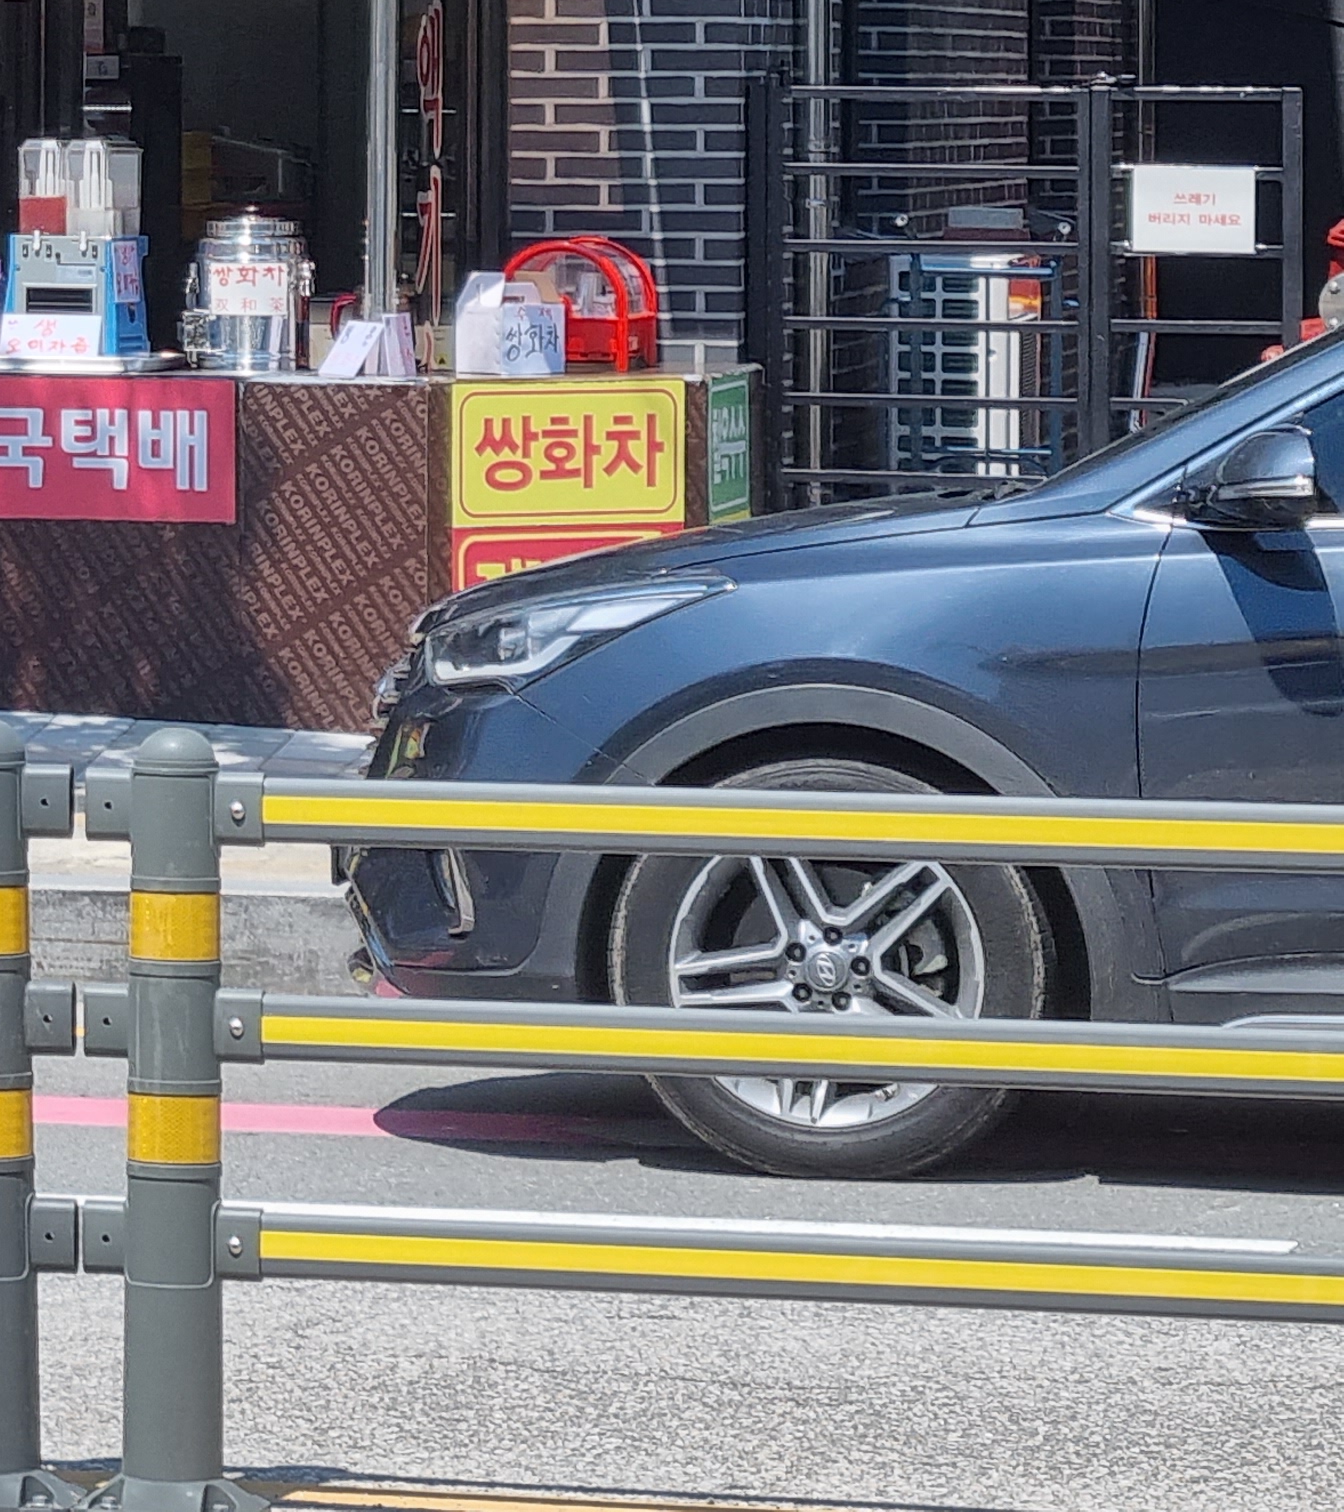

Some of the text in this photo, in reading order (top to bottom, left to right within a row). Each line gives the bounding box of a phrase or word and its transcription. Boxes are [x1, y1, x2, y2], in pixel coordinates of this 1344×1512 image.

[1148, 212, 1241, 225] 버리지 마세요
[1173, 192, 1215, 206] 쓰레기
[213, 265, 285, 287] 쌍화차
[34, 319, 58, 338] 생
[505, 322, 559, 362] 쌍화차
[356, 425, 427, 533] KORINPLEX
[473, 412, 666, 492] 쌍화차
[280, 480, 355, 586] KORINPLEX
[305, 463, 380, 569] KORINPLEX
[330, 444, 405, 550] KORINPLEX
[256, 499, 330, 604] KORINPLEX
